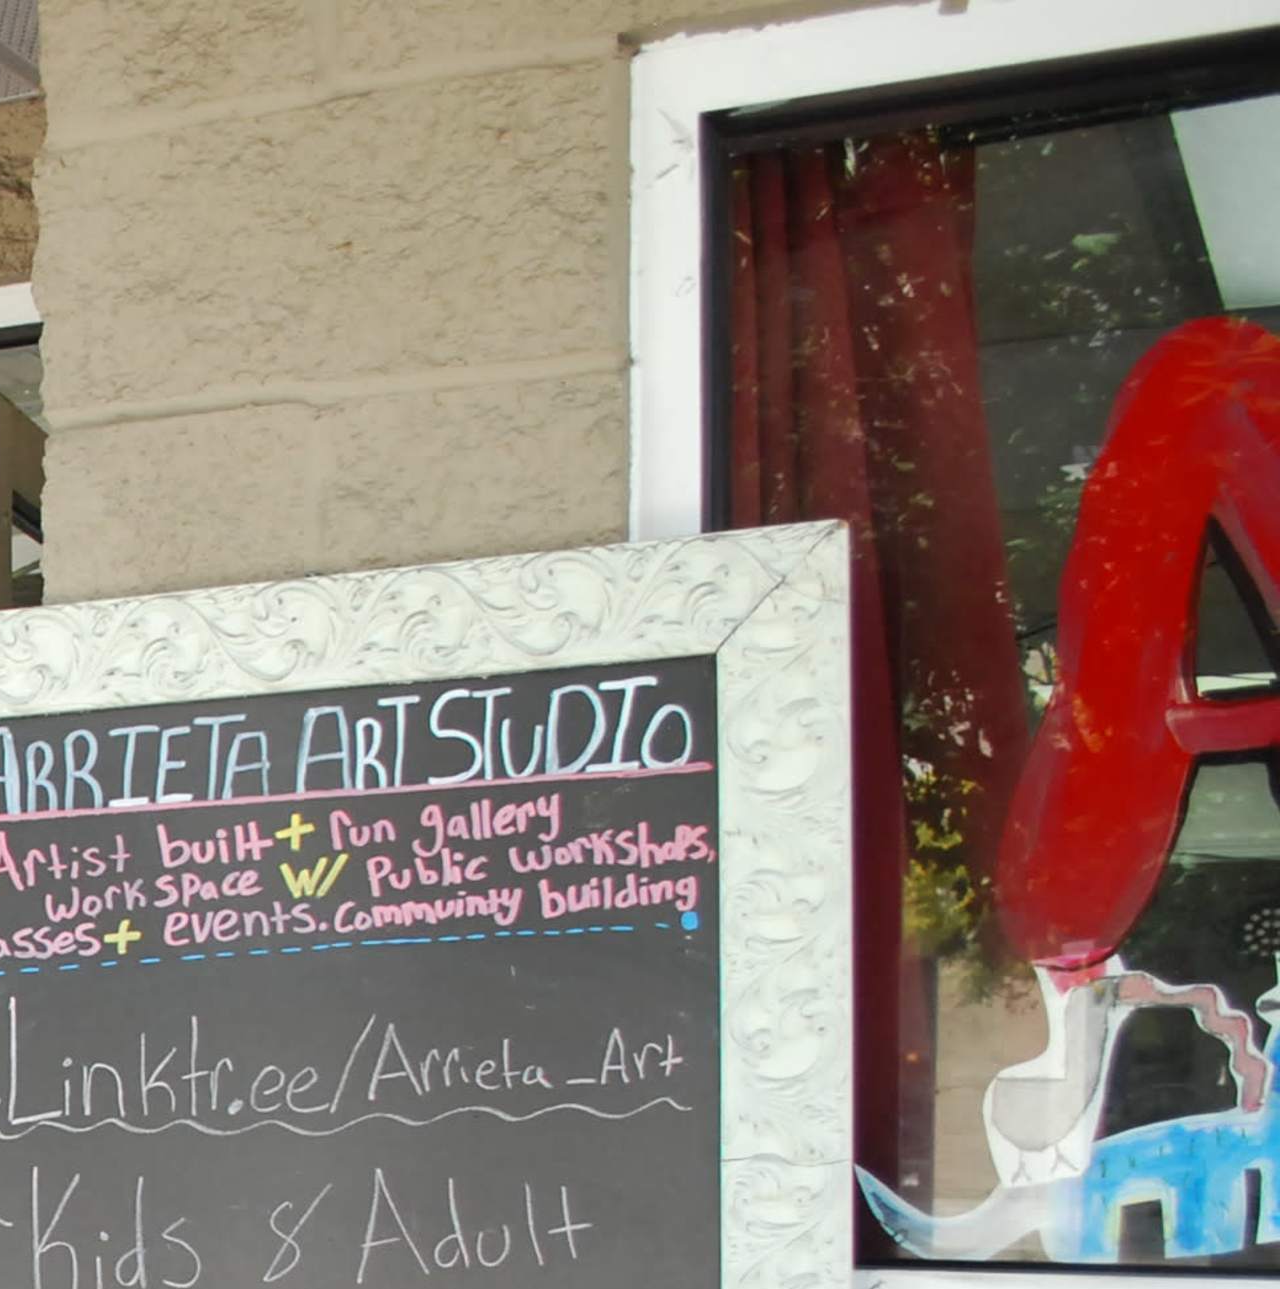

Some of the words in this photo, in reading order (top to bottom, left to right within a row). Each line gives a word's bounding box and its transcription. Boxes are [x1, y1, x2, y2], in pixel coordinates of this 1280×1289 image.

[296, 694, 421, 794] ART
[427, 676, 694, 786] STUDIO
[156, 820, 274, 868] built
[328, 809, 397, 852] run
[411, 793, 561, 858] gallery
[539, 874, 698, 920] building
[356, 1167, 594, 1285] Adult
